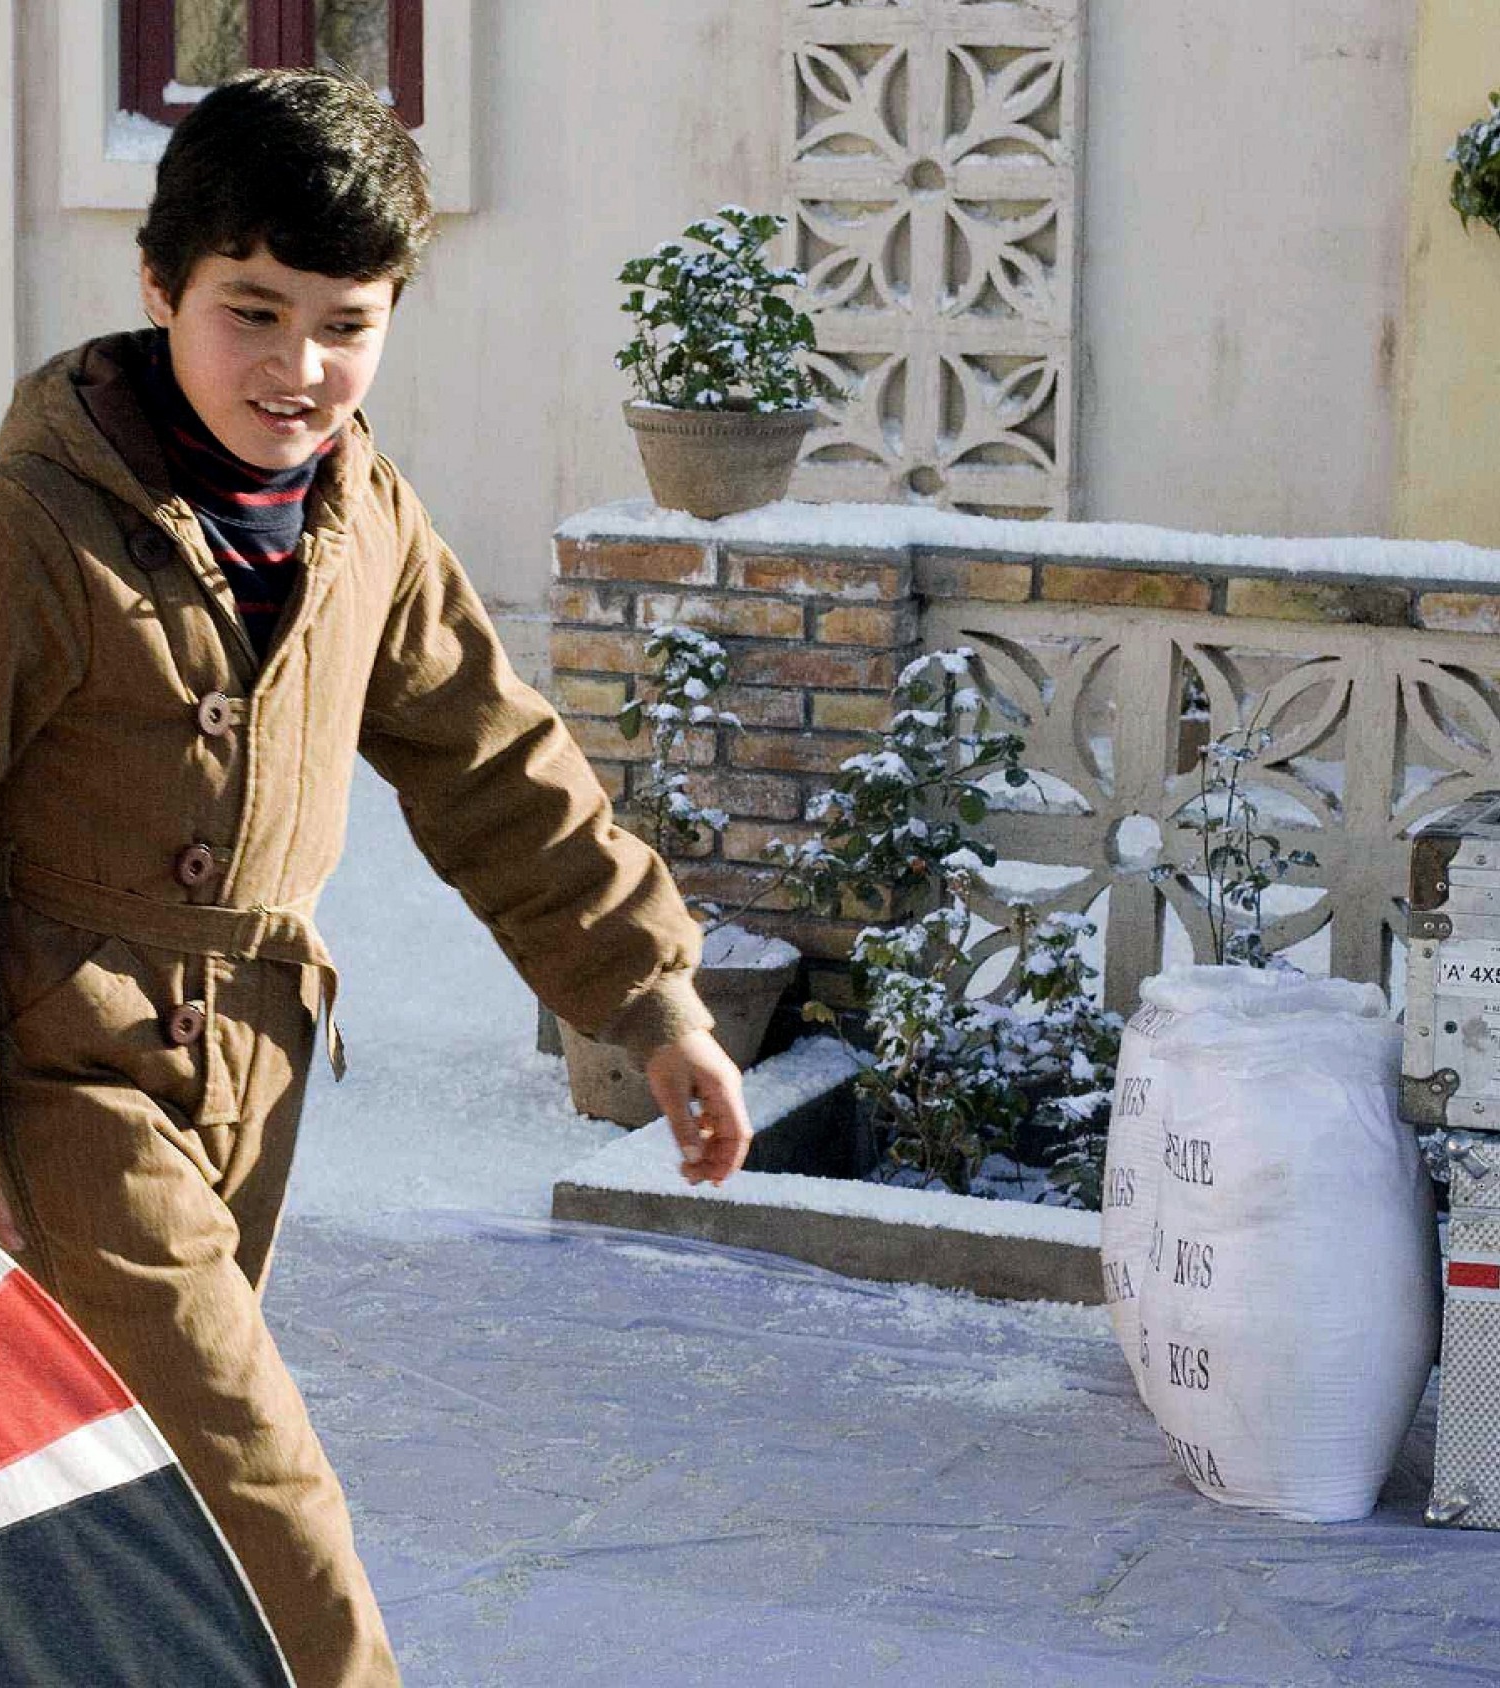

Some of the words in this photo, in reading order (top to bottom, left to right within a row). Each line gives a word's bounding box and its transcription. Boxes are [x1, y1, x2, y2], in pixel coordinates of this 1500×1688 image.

[1443, 963, 1465, 981] 'A'
[1117, 1077, 1152, 1117] KGS
[1173, 1238, 1214, 1290] KGS
[1168, 1342, 1209, 1391] KGS
